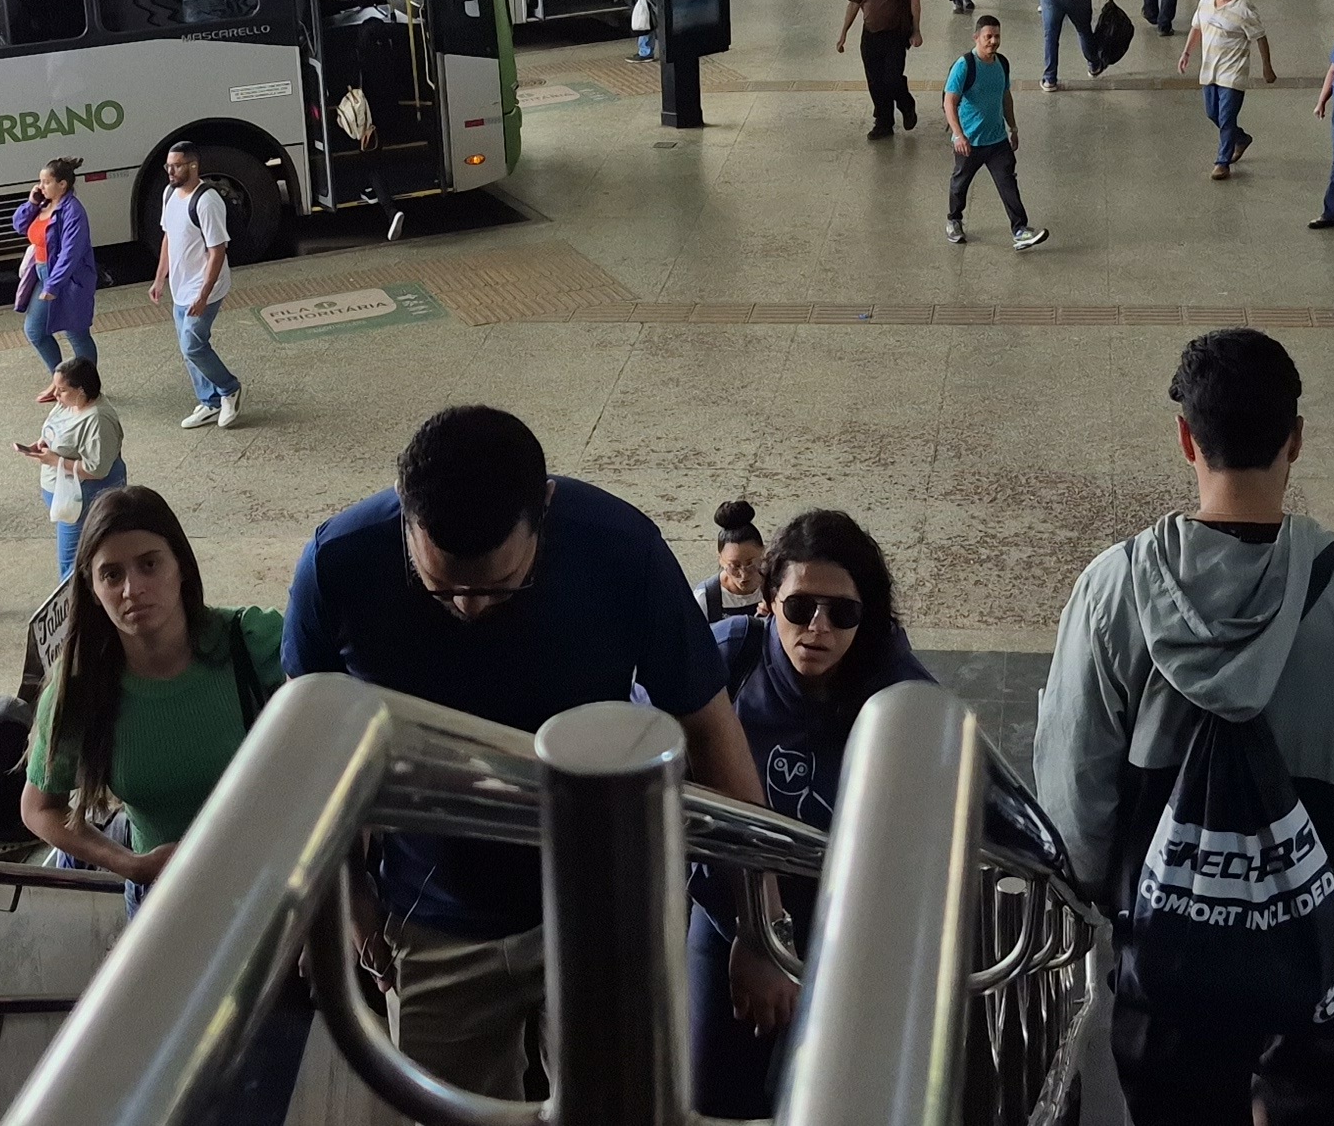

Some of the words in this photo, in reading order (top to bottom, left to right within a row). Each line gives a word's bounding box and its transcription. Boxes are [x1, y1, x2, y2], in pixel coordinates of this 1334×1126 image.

[181, 24, 271, 43] MASCARELLO
[269, 307, 311, 318] FILA
[274, 301, 388, 324] PRIORITÁRIA
